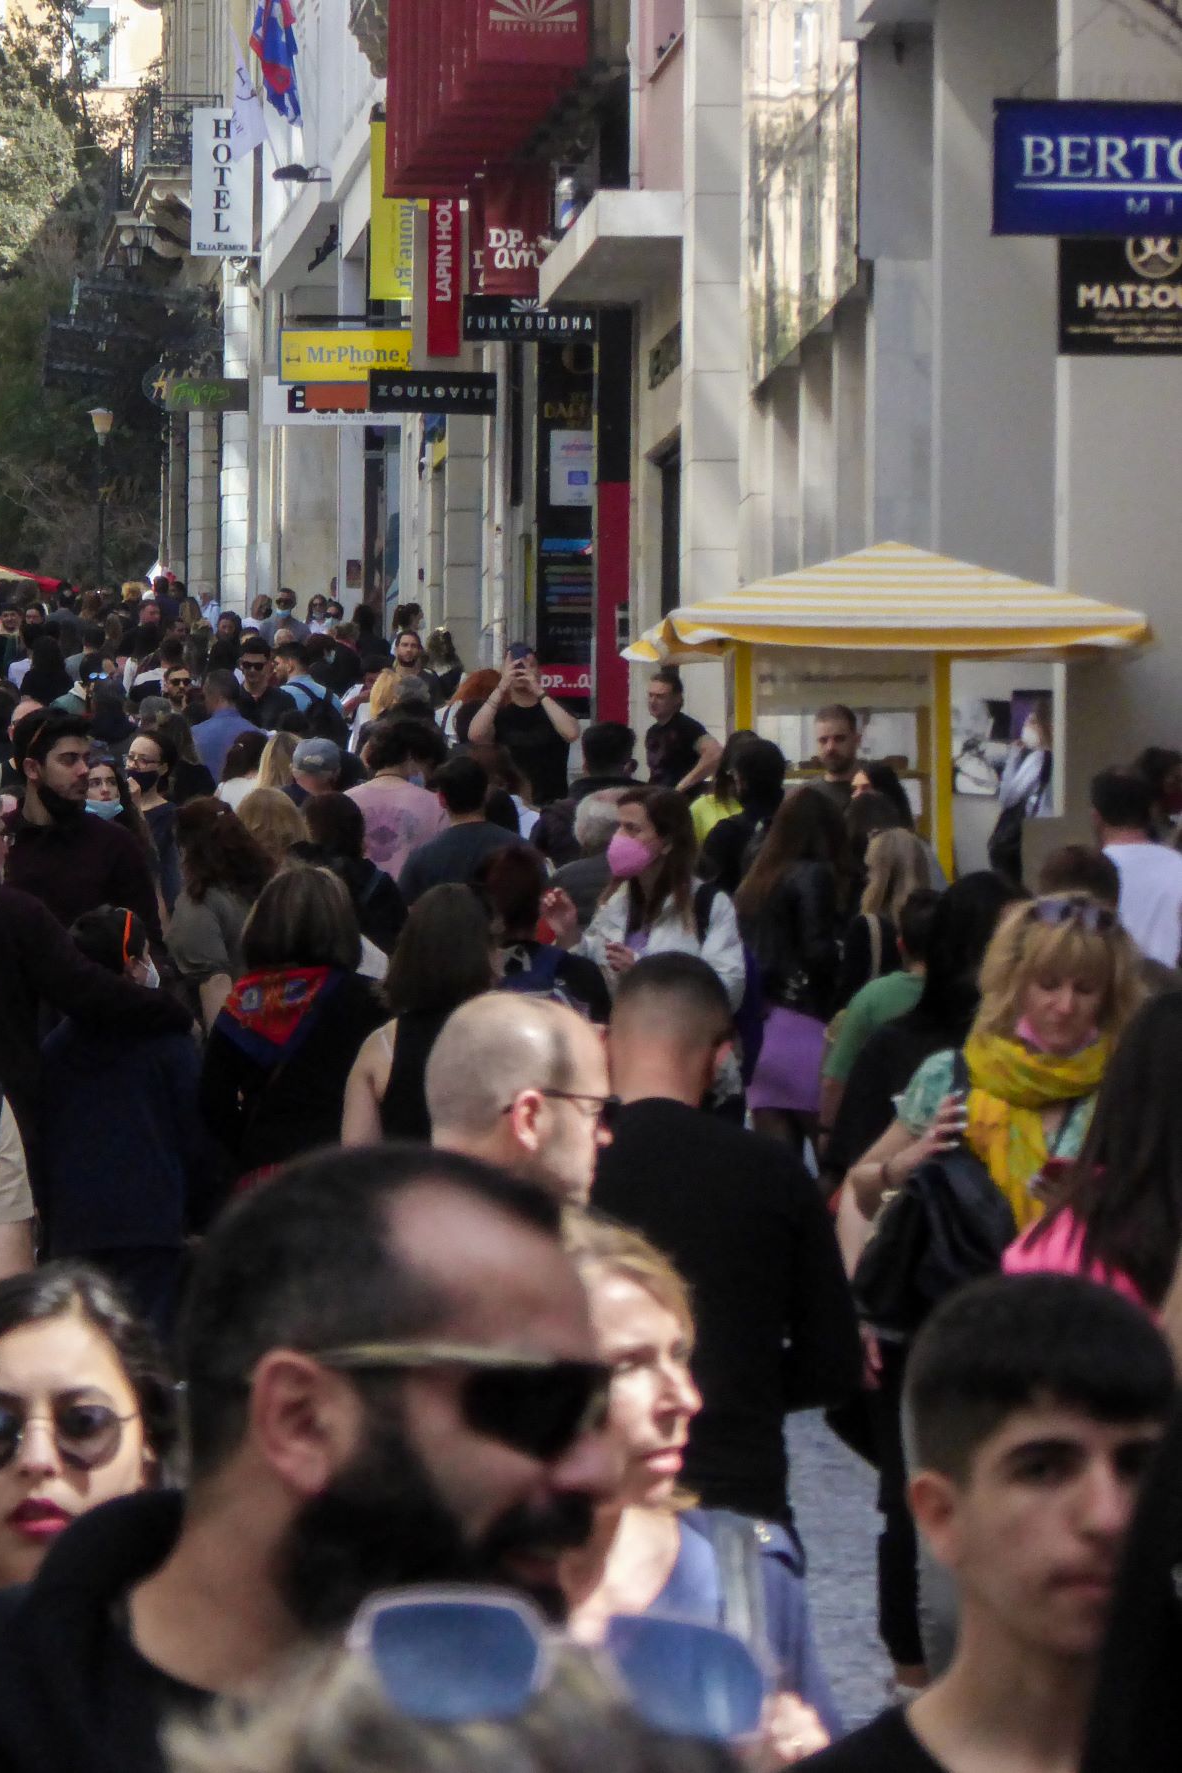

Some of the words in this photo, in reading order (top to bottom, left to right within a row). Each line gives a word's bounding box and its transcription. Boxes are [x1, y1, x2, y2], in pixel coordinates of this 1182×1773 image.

[212, 118, 232, 234] HOTEL
[435, 244, 453, 301] LAPIN
[466, 315, 593, 330] FUNKYBUDDHA
